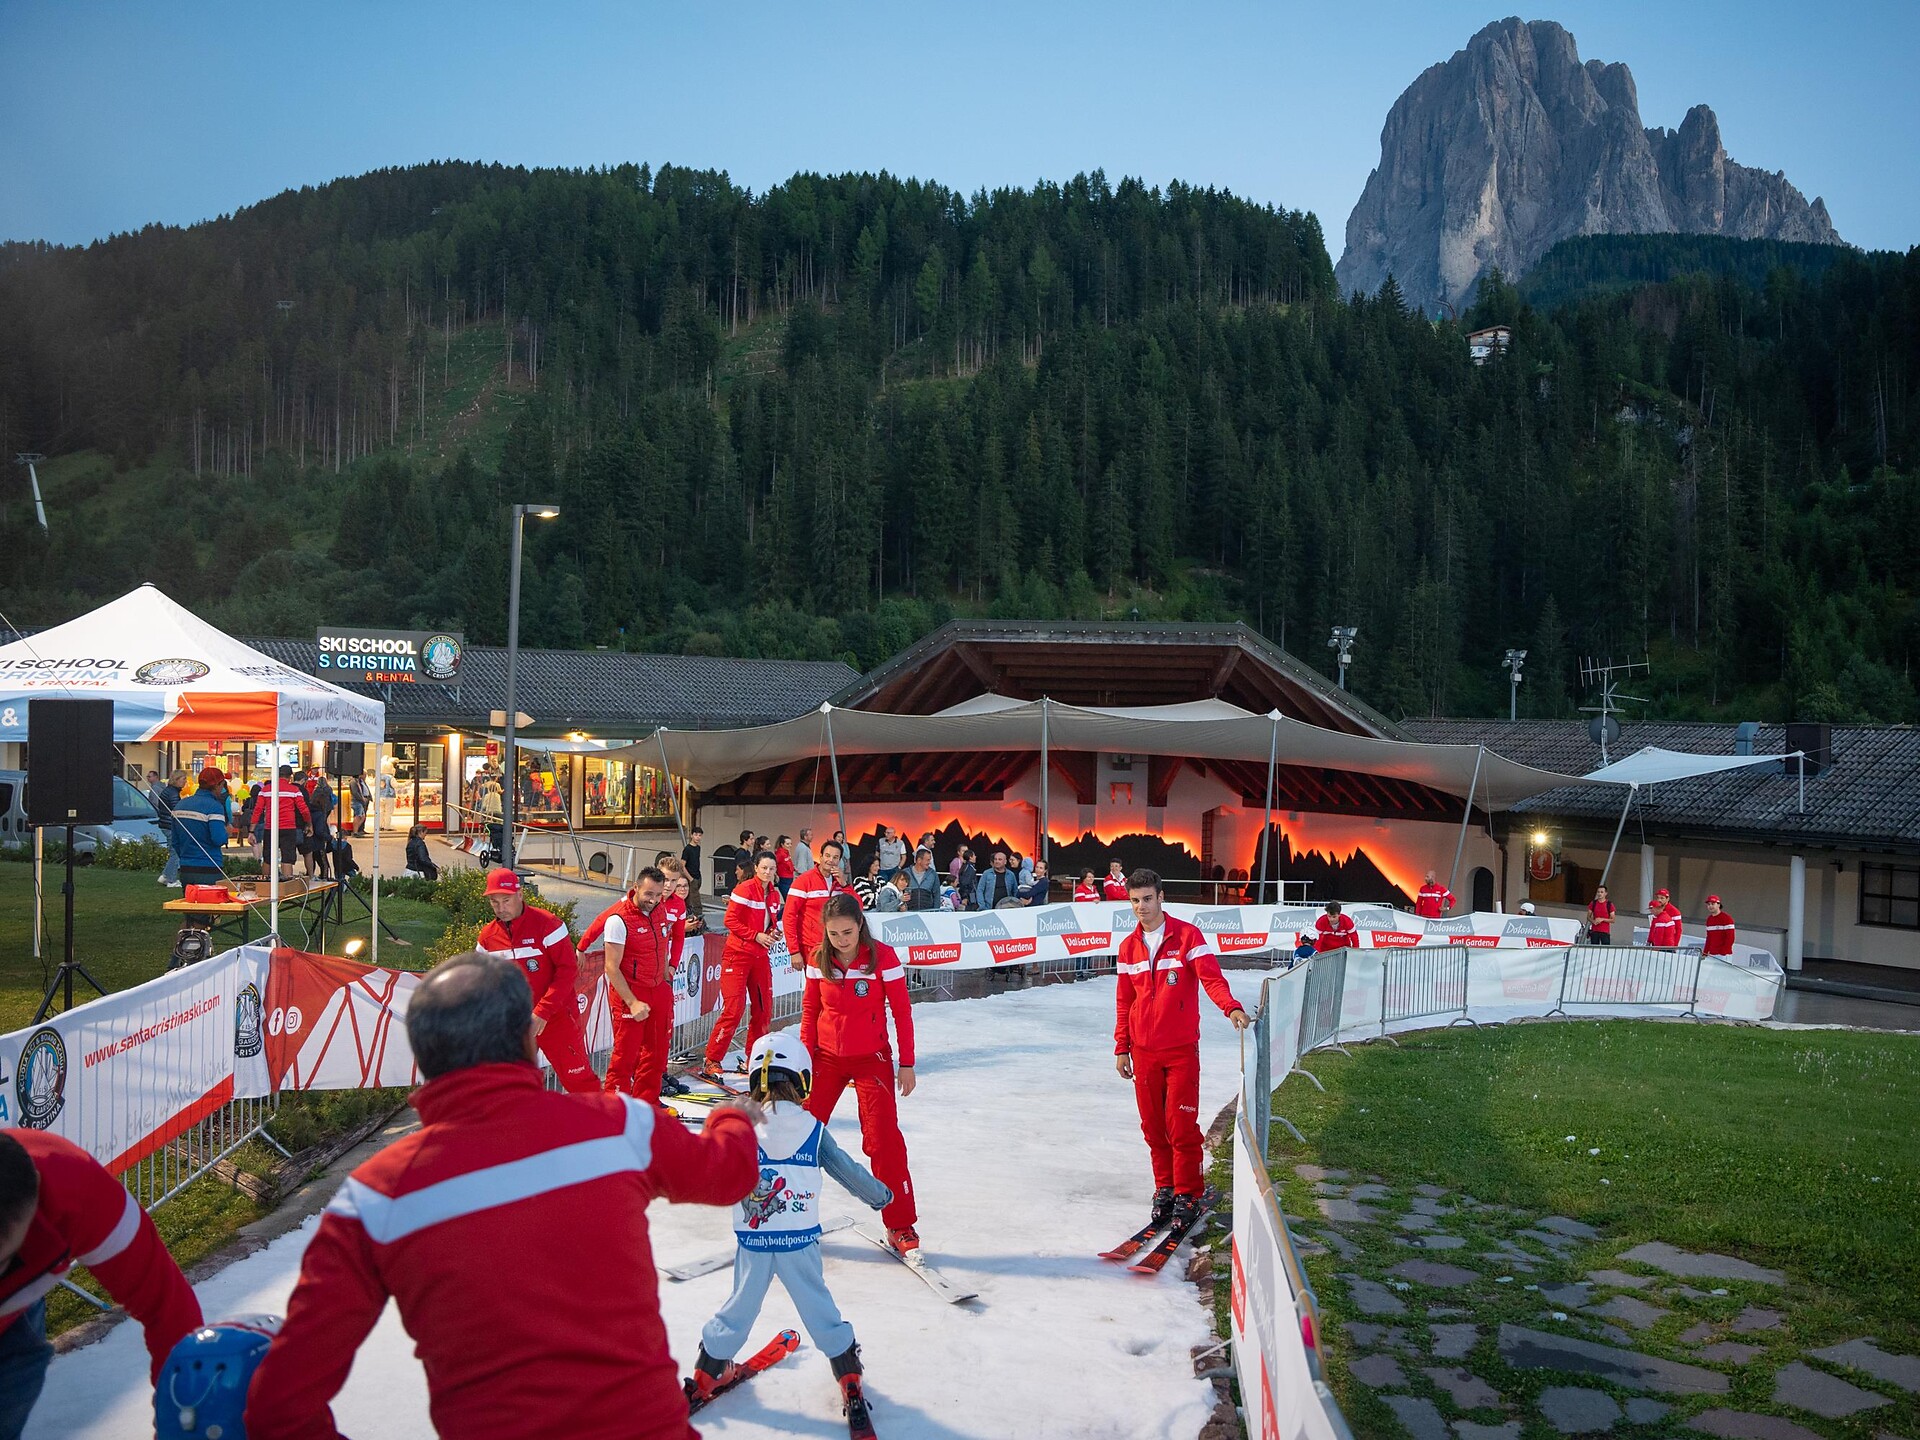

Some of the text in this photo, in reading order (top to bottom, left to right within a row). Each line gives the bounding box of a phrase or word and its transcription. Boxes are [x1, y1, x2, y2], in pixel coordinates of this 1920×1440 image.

[319, 636, 417, 655] SKI SCHOOL
[15, 658, 129, 680] SCHOOL
[319, 654, 416, 671] S. CRISTINA
[365, 672, 415, 682] & RENTAL
[1, 707, 19, 727] &
[291, 701, 322, 721] Follow
[325, 701, 339, 721] the
[1195, 917, 1241, 931] Dolomites
[1354, 915, 1394, 929] Dolomites
[1427, 921, 1471, 934] Dolomites
[1505, 922, 1548, 936] Dolomites
[884, 925, 929, 943] Dolomites
[962, 923, 1006, 938] Dolomites
[1066, 938, 1077, 947] Val
[1220, 937, 1264, 946] Val Gardena
[1375, 934, 1416, 944] Val Gardena
[1465, 939, 1495, 947] Gardena
[913, 949, 958, 961] Val Gardena
[993, 943, 1034, 954] Val Gardena
[84, 994, 220, 1068] www.santacristinaski.com
[32, 1103, 62, 1131] CRISTINA
[784, 1190, 815, 1201] Dumbo
[792, 1201, 809, 1213] Ski
